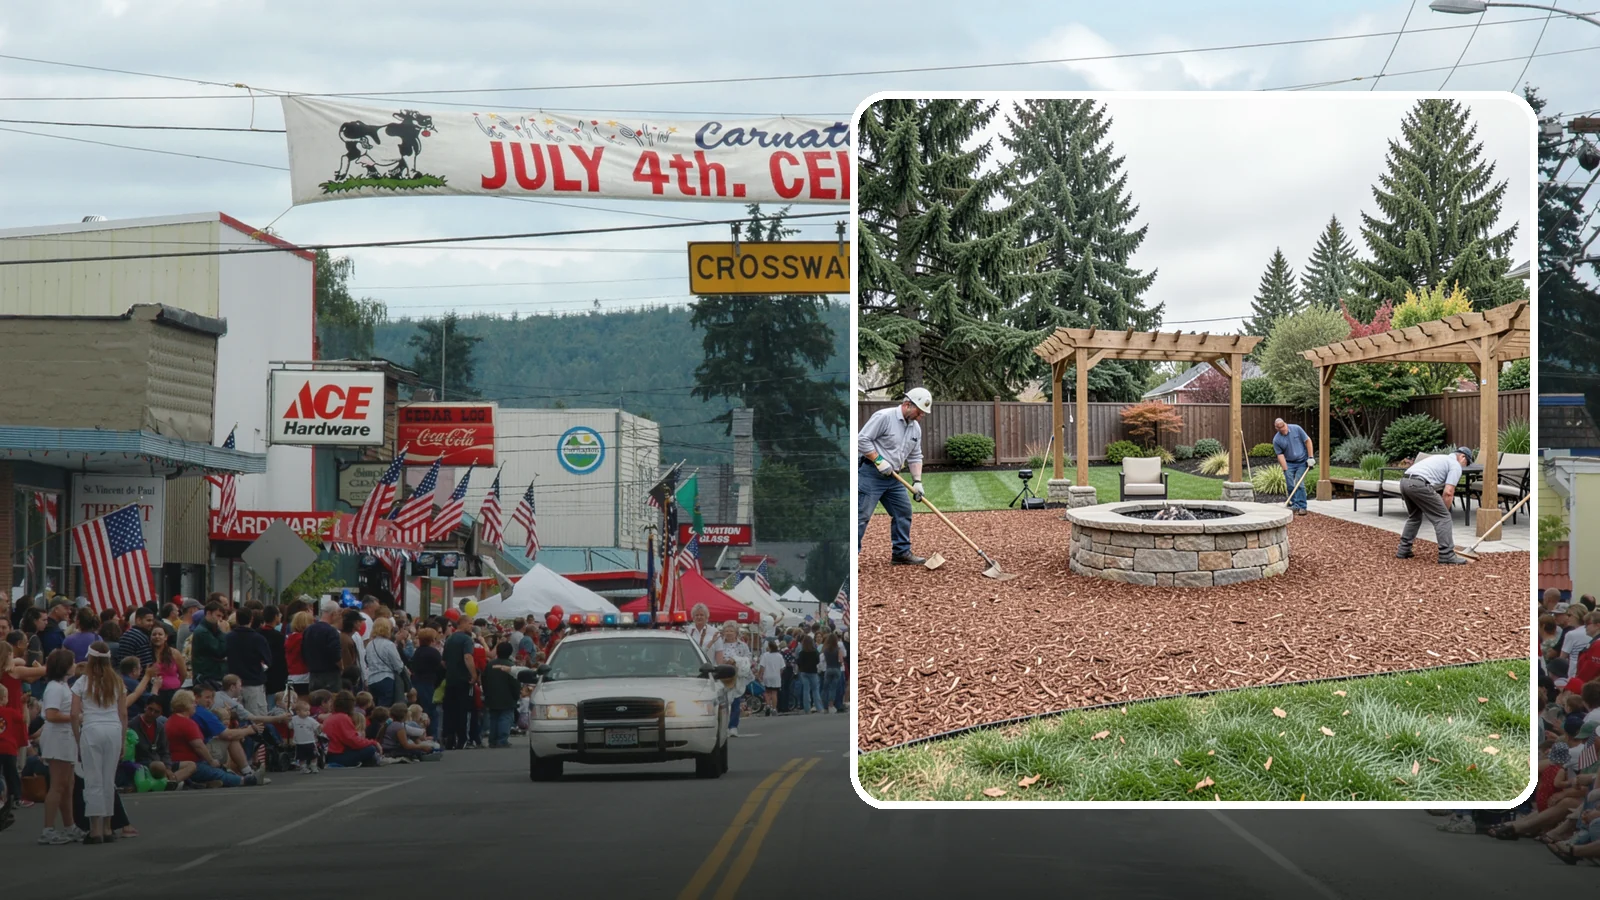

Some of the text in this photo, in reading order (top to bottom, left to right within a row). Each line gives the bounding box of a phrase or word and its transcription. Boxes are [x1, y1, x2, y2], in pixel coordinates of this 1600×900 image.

[694, 121, 850, 150] Carnat
[481, 139, 605, 193] JULY
[631, 148, 746, 198] 4th.
[696, 254, 850, 280] CROSSWA
[282, 379, 374, 420] ACE
[405, 409, 452, 422] CEDAR
[283, 420, 371, 436] Hardware
[353, 467, 386, 481] Simpl
[95, 484, 124, 495] Vincent
[126, 486, 136, 495] de
[137, 486, 155, 495] Paul
[687, 526, 741, 535] CRNATION
[699, 535, 730, 543] GLASS
